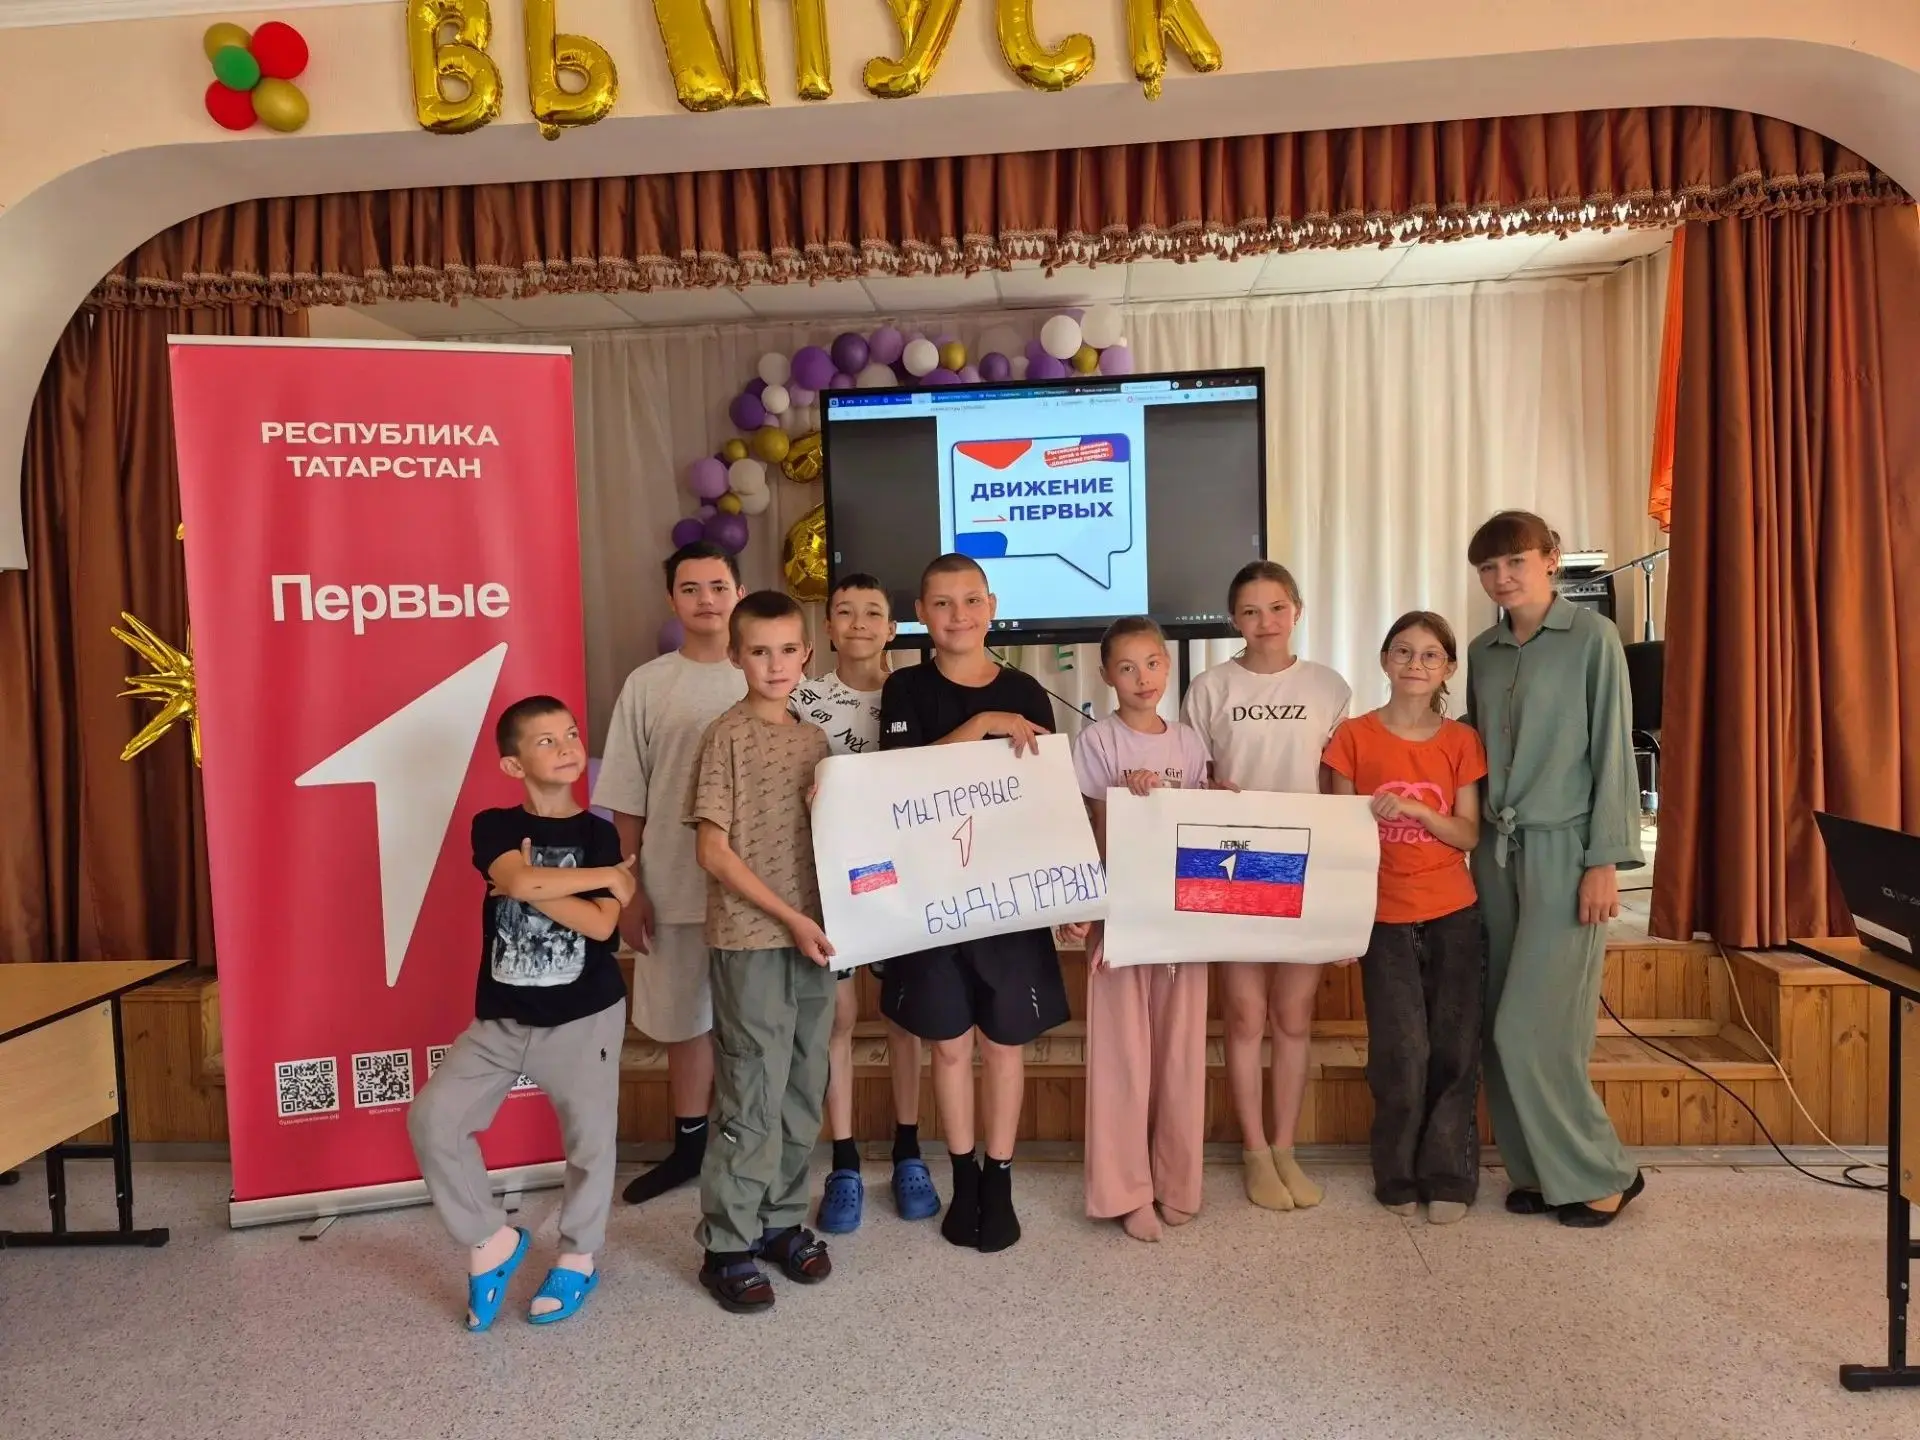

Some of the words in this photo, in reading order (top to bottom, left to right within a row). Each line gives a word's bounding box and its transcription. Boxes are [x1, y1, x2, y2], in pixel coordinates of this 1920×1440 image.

[260, 421, 500, 447] РЕСПУБЛИКА
[285, 455, 482, 479] ТАТАРСТАН
[970, 476, 1114, 502] ДВИЖЕНИЕ
[1008, 501, 1114, 522] ПЕРВЫХ
[270, 573, 511, 636] Первые
[1231, 704, 1308, 722] DGXZZ
[891, 720, 908, 734] NBA
[1164, 767, 1184, 778] Girl
